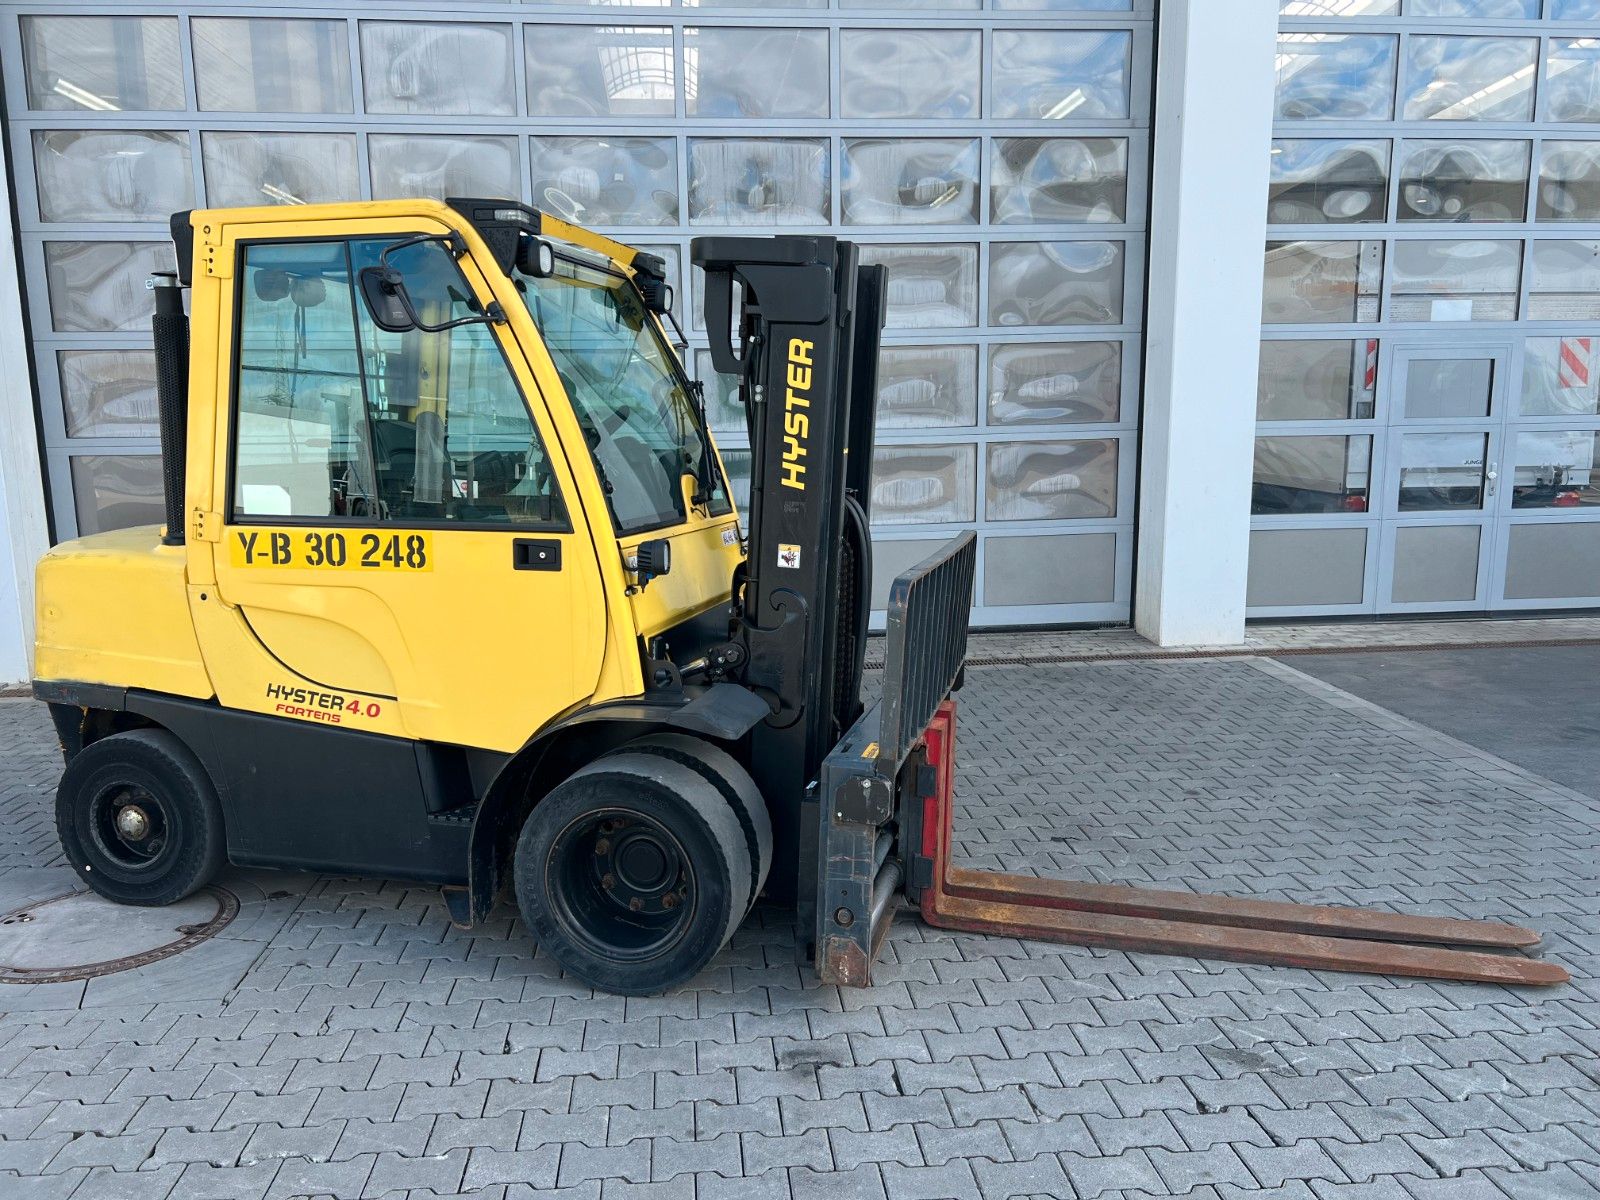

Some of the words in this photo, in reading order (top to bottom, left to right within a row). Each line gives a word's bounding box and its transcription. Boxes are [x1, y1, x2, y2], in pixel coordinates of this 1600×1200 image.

[781, 337, 814, 491] HYSTER
[237, 532, 292, 565] Y-B
[305, 532, 347, 567] 30
[360, 533, 426, 569] 248
[266, 683, 345, 711] HYSTER
[346, 700, 381, 718] 4.0
[276, 703, 342, 723] FORTENS
